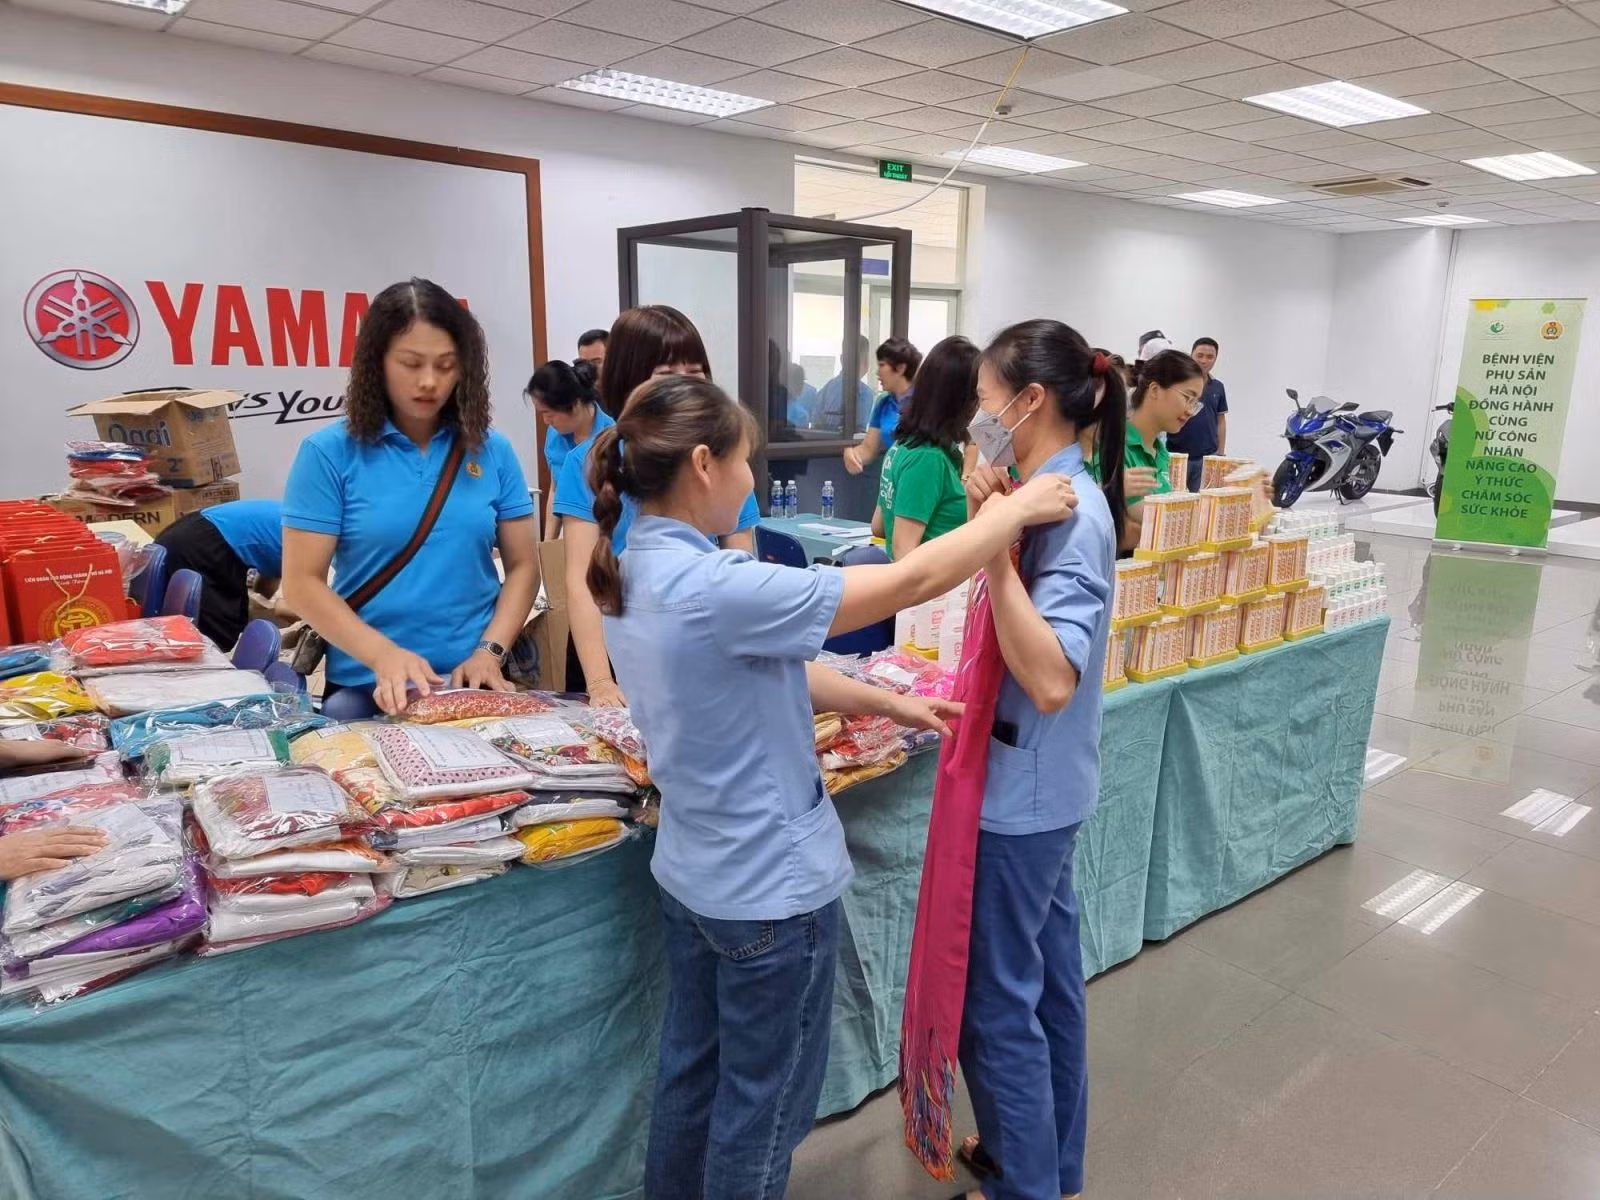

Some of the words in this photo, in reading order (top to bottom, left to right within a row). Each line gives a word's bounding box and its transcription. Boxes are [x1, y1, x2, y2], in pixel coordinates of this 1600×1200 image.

[887, 163, 904, 172] EXIT
[145, 280, 470, 368] YAMA
[1482, 353, 1520, 367] BỆNH
[1523, 353, 1555, 367] VIỆN
[1486, 370, 1515, 382] PHỤ
[1518, 368, 1546, 380] SẢN
[1489, 384, 1508, 395] HÀ
[1512, 384, 1537, 398] NỘI
[275, 390, 346, 424] You
[1513, 400, 1554, 412] HÀNH
[1489, 414, 1528, 426] CÙNG
[1475, 429, 1496, 441] NỮ
[1499, 430, 1537, 442] CÔNG
[1484, 446, 1524, 457] NHÂN
[1466, 459, 1505, 471] NÂNG
[1508, 462, 1537, 473] CAO
[1475, 473, 1483, 485] Ý
[1486, 476, 1523, 488] THỨC
[1461, 489, 1501, 501] CHĂM
[1504, 491, 1533, 504] SÓC
[1461, 503, 1488, 515] SỨC
[1490, 505, 1529, 518] KHỎE
